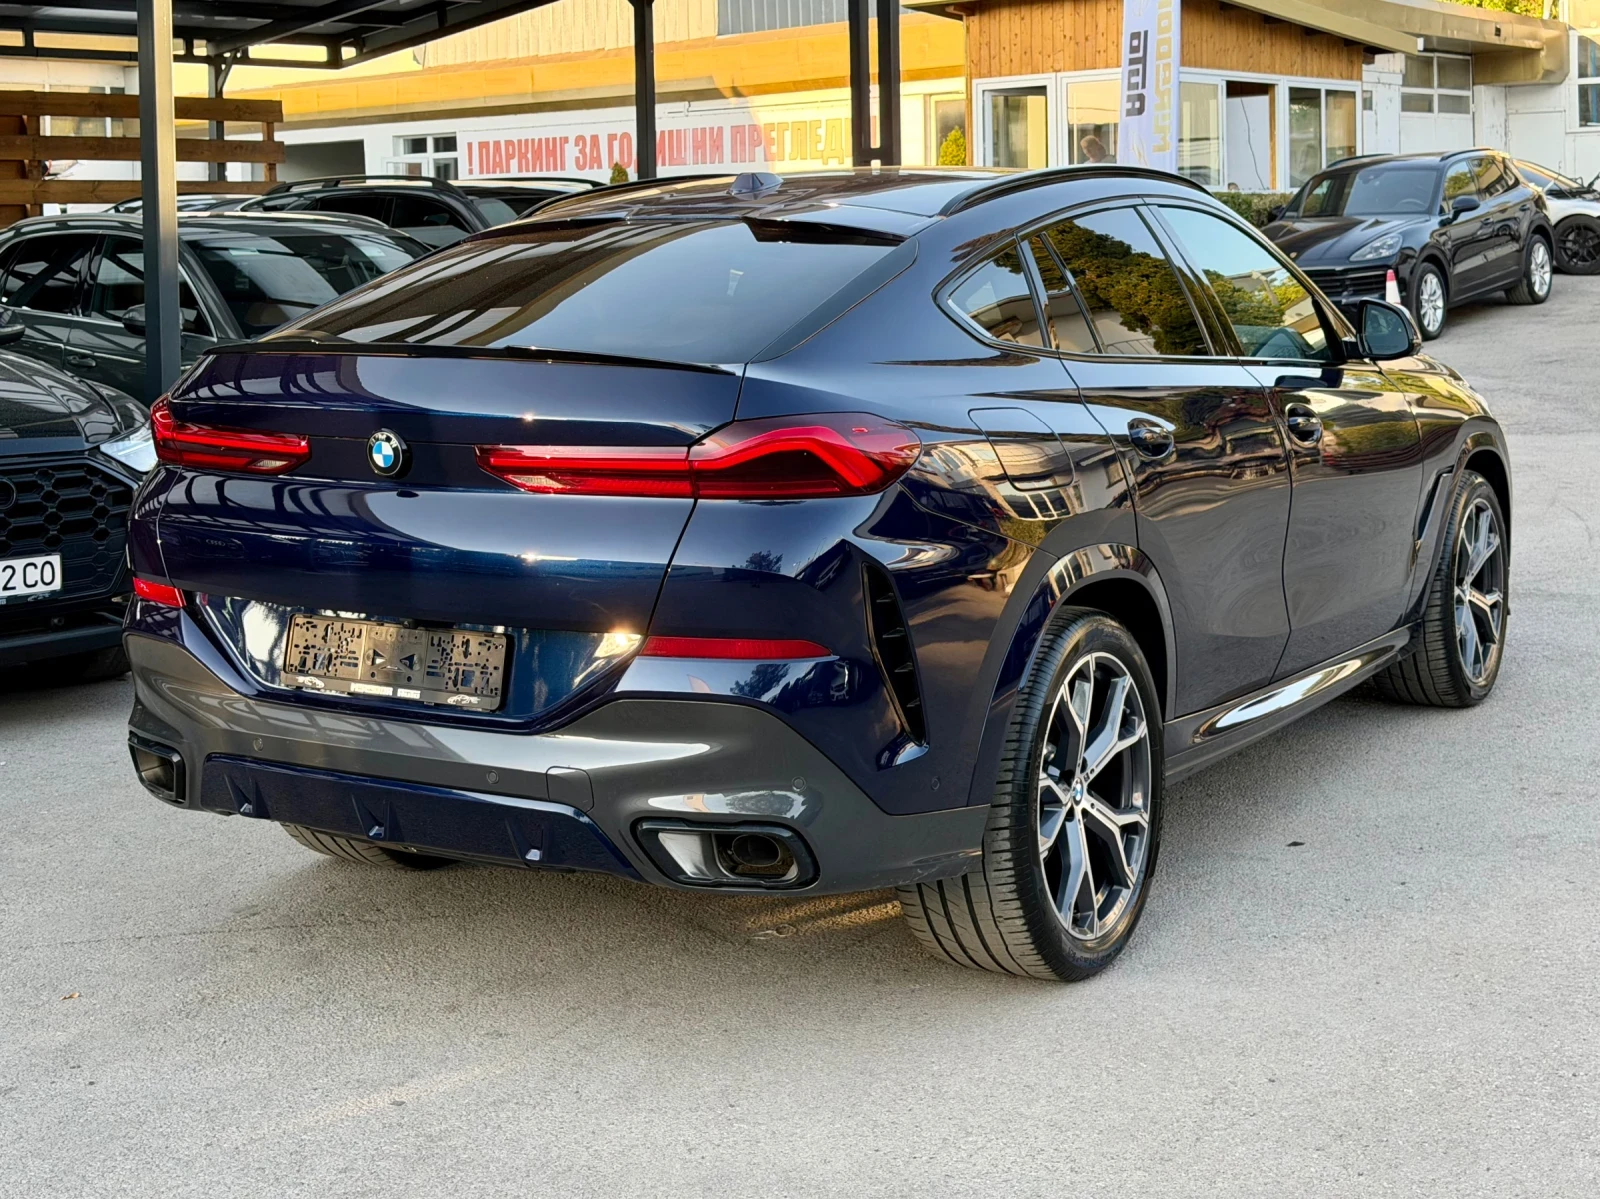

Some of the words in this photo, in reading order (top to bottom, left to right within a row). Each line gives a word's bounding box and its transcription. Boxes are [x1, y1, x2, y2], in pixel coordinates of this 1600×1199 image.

[478, 136, 569, 175] ПАРКИНГ
[574, 134, 603, 171] ЗА
[607, 126, 724, 174] ГОИШНИ
